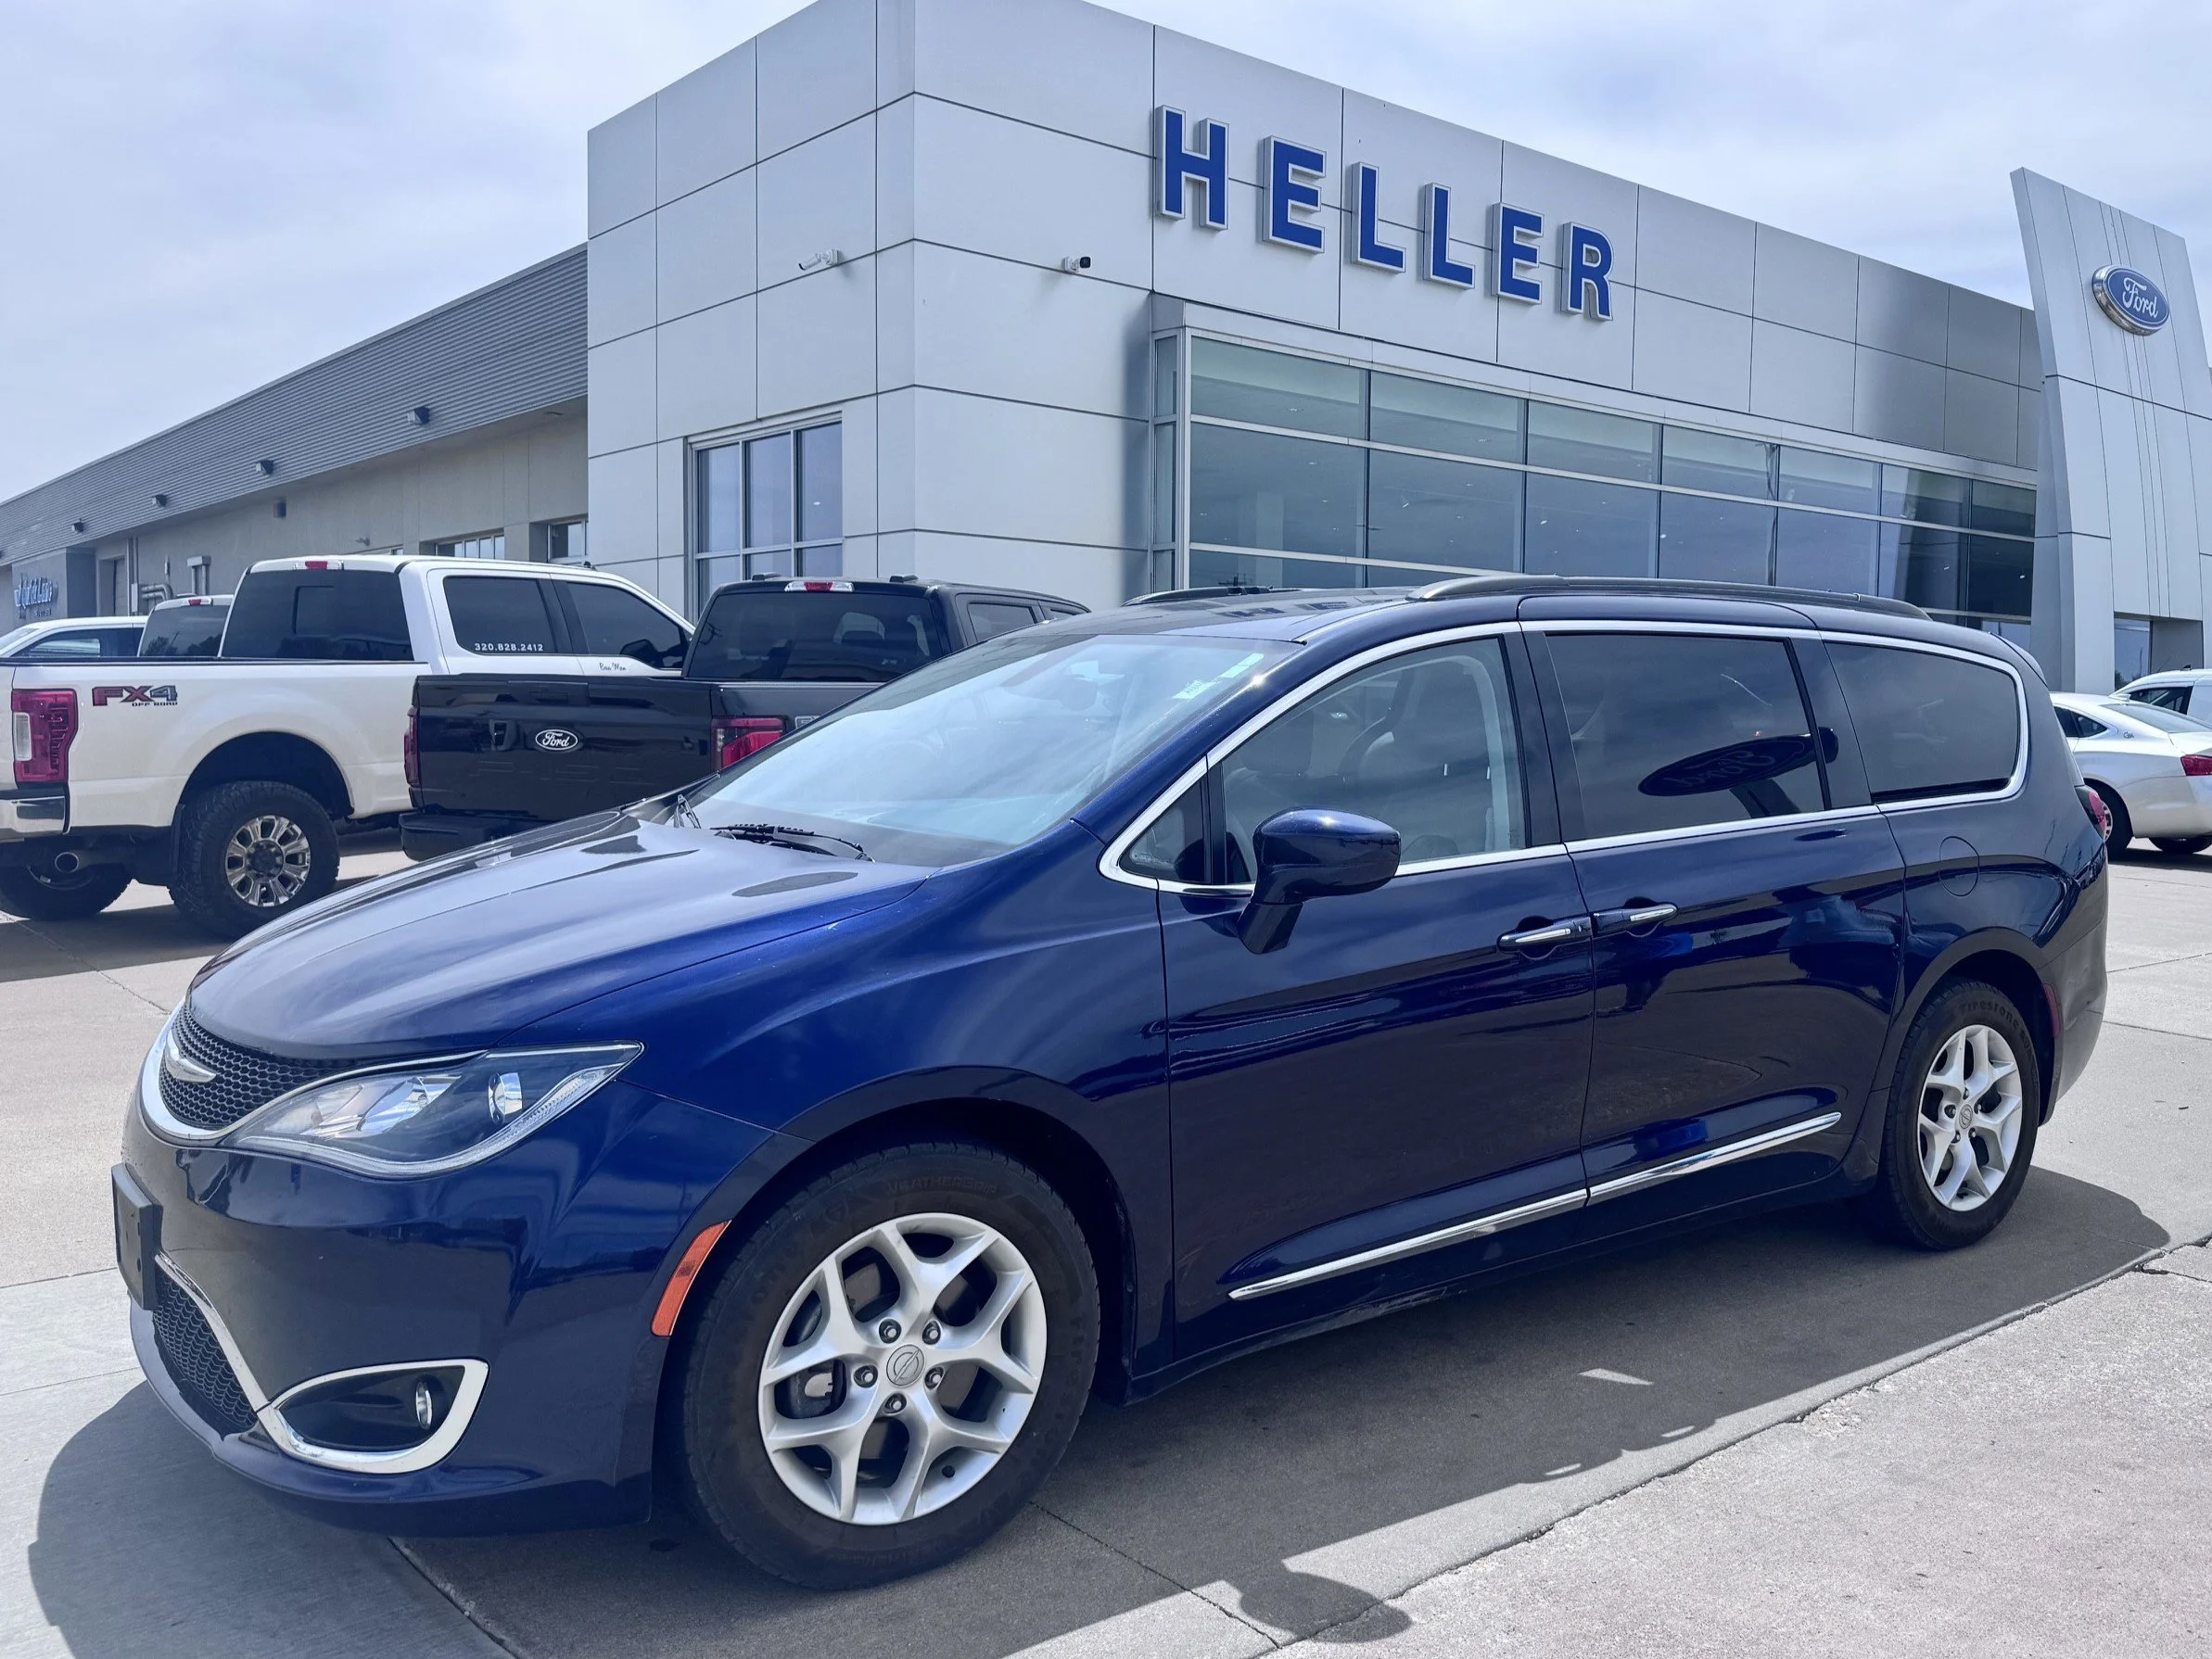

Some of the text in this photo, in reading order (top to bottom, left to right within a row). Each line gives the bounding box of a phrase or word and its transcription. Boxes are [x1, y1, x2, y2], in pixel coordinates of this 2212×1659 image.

[1154, 105, 1614, 322] HELLER
[2122, 277, 2159, 319] Ford
[92, 685, 178, 706] FX4
[542, 731, 570, 747] Ford
[1958, 1000, 2020, 1030] Firestone
